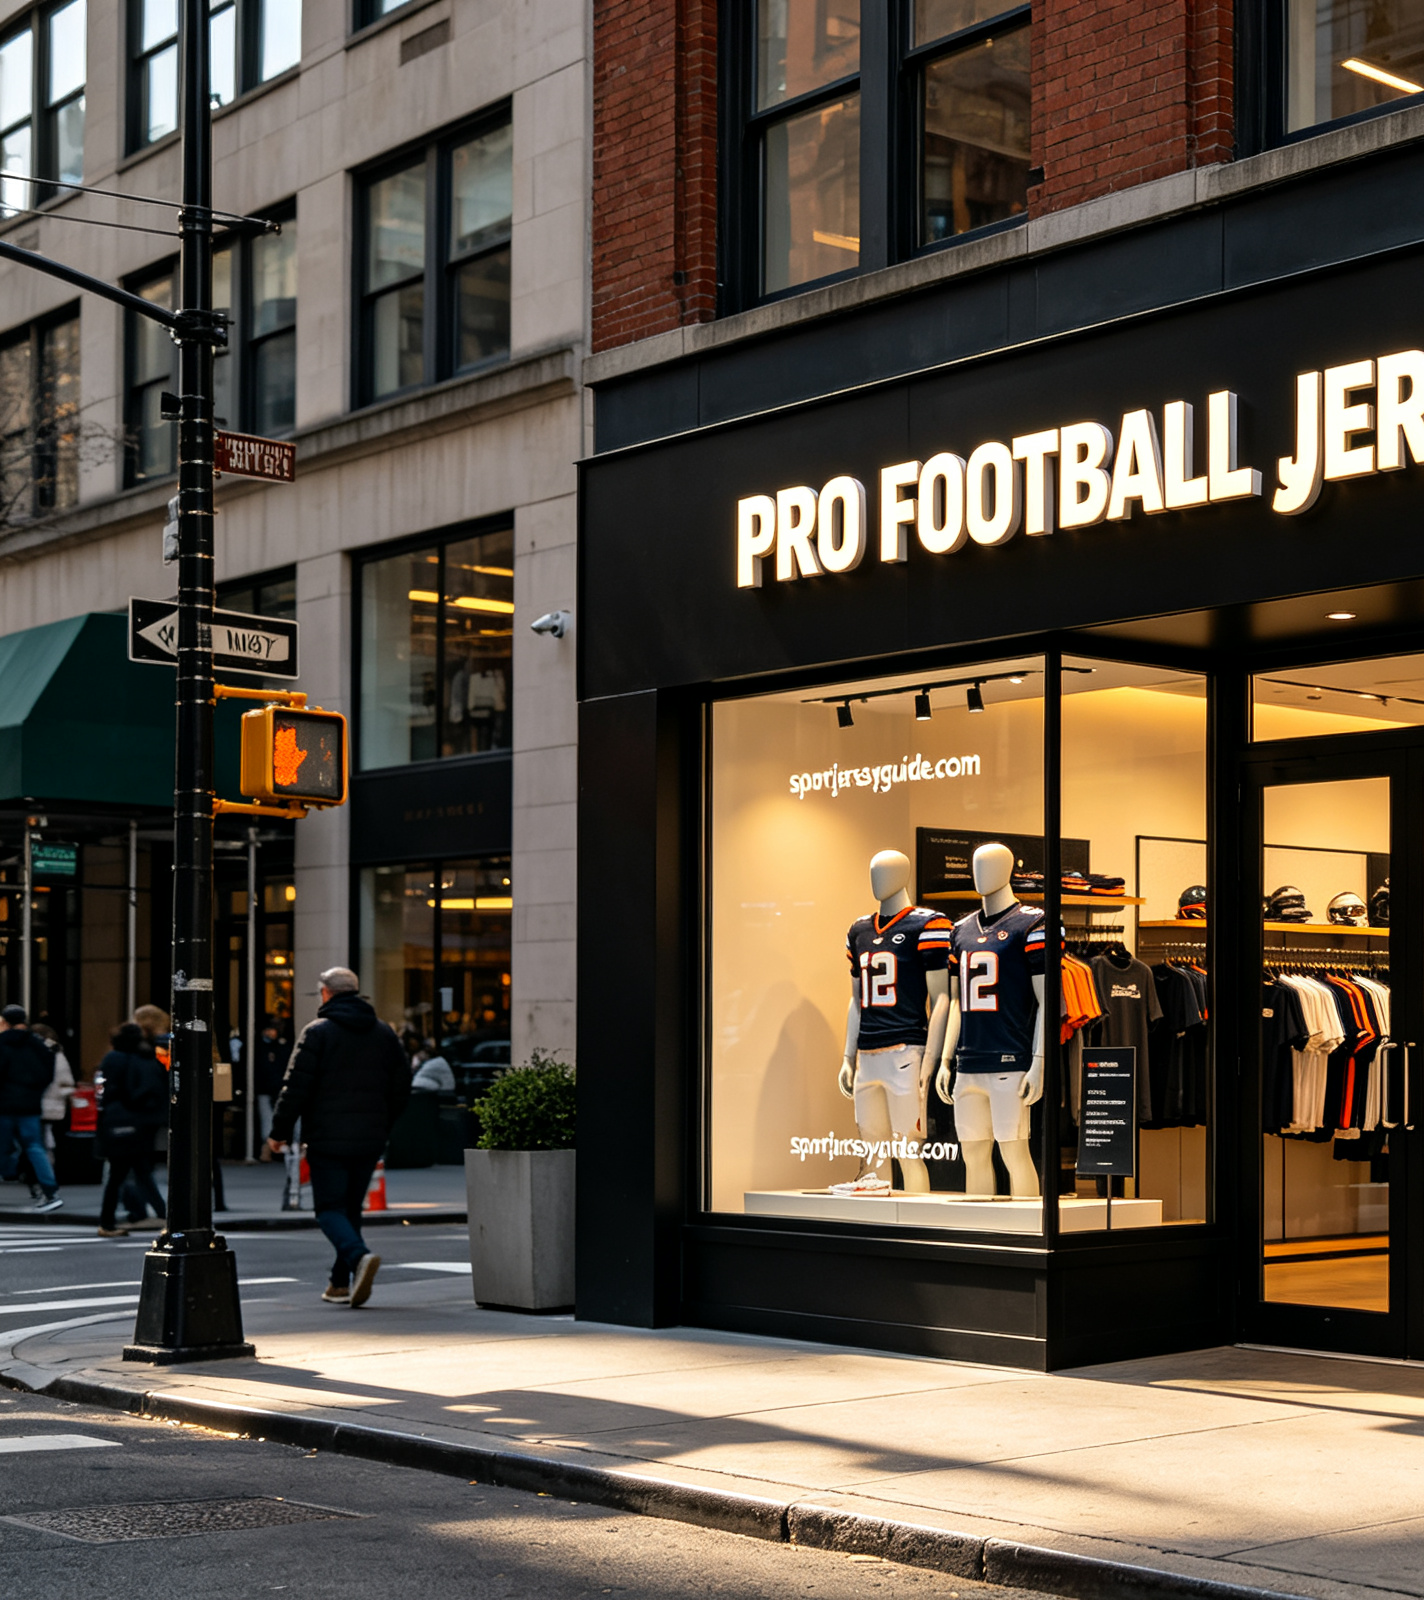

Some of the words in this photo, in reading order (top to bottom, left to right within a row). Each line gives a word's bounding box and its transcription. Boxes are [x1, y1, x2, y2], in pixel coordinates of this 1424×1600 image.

[737, 475, 866, 589] PRO
[880, 390, 1262, 563] FOOTBALL
[859, 951, 897, 1008] 12
[960, 950, 999, 1012] 12
